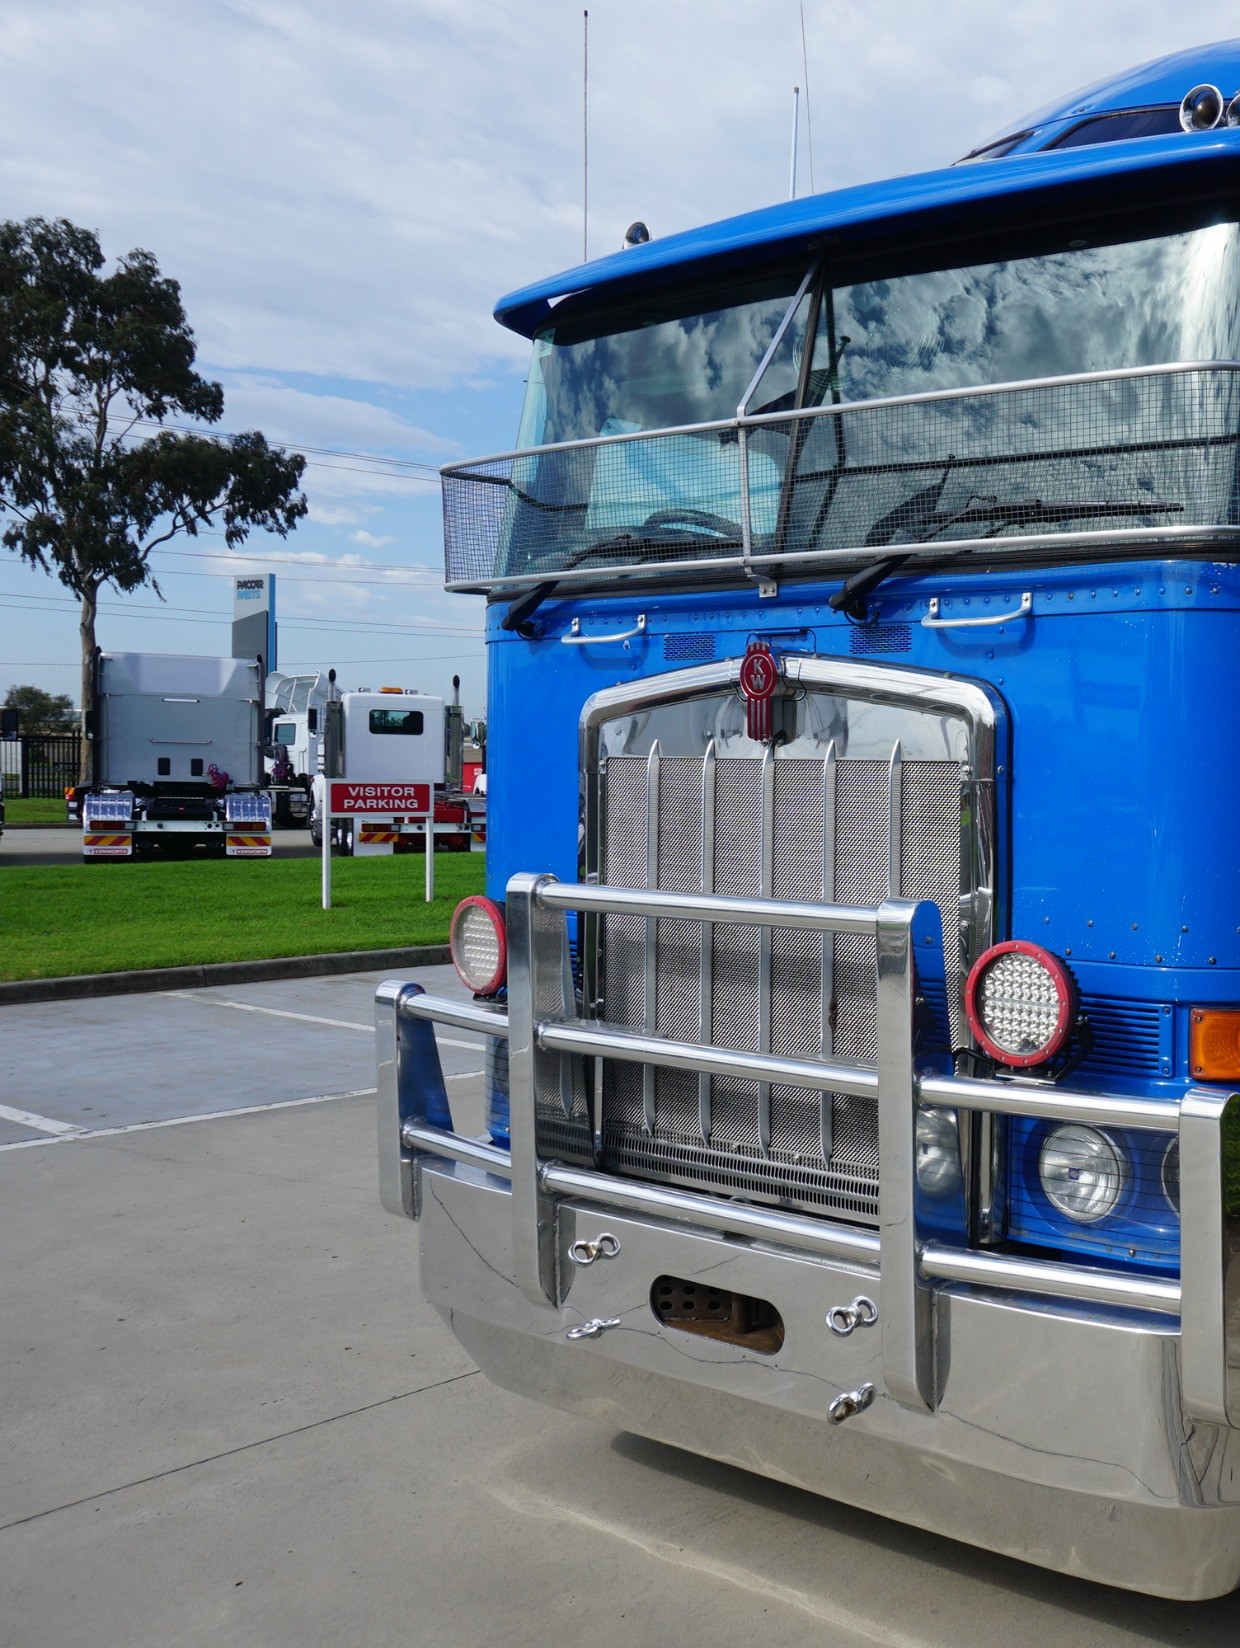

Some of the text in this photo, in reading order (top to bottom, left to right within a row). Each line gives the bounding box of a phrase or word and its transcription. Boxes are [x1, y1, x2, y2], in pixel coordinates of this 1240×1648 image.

[236, 579, 264, 590] PACCAR
[236, 589, 261, 600] PARTS
[347, 786, 415, 797] VISITOR
[343, 799, 419, 809] PARKING
